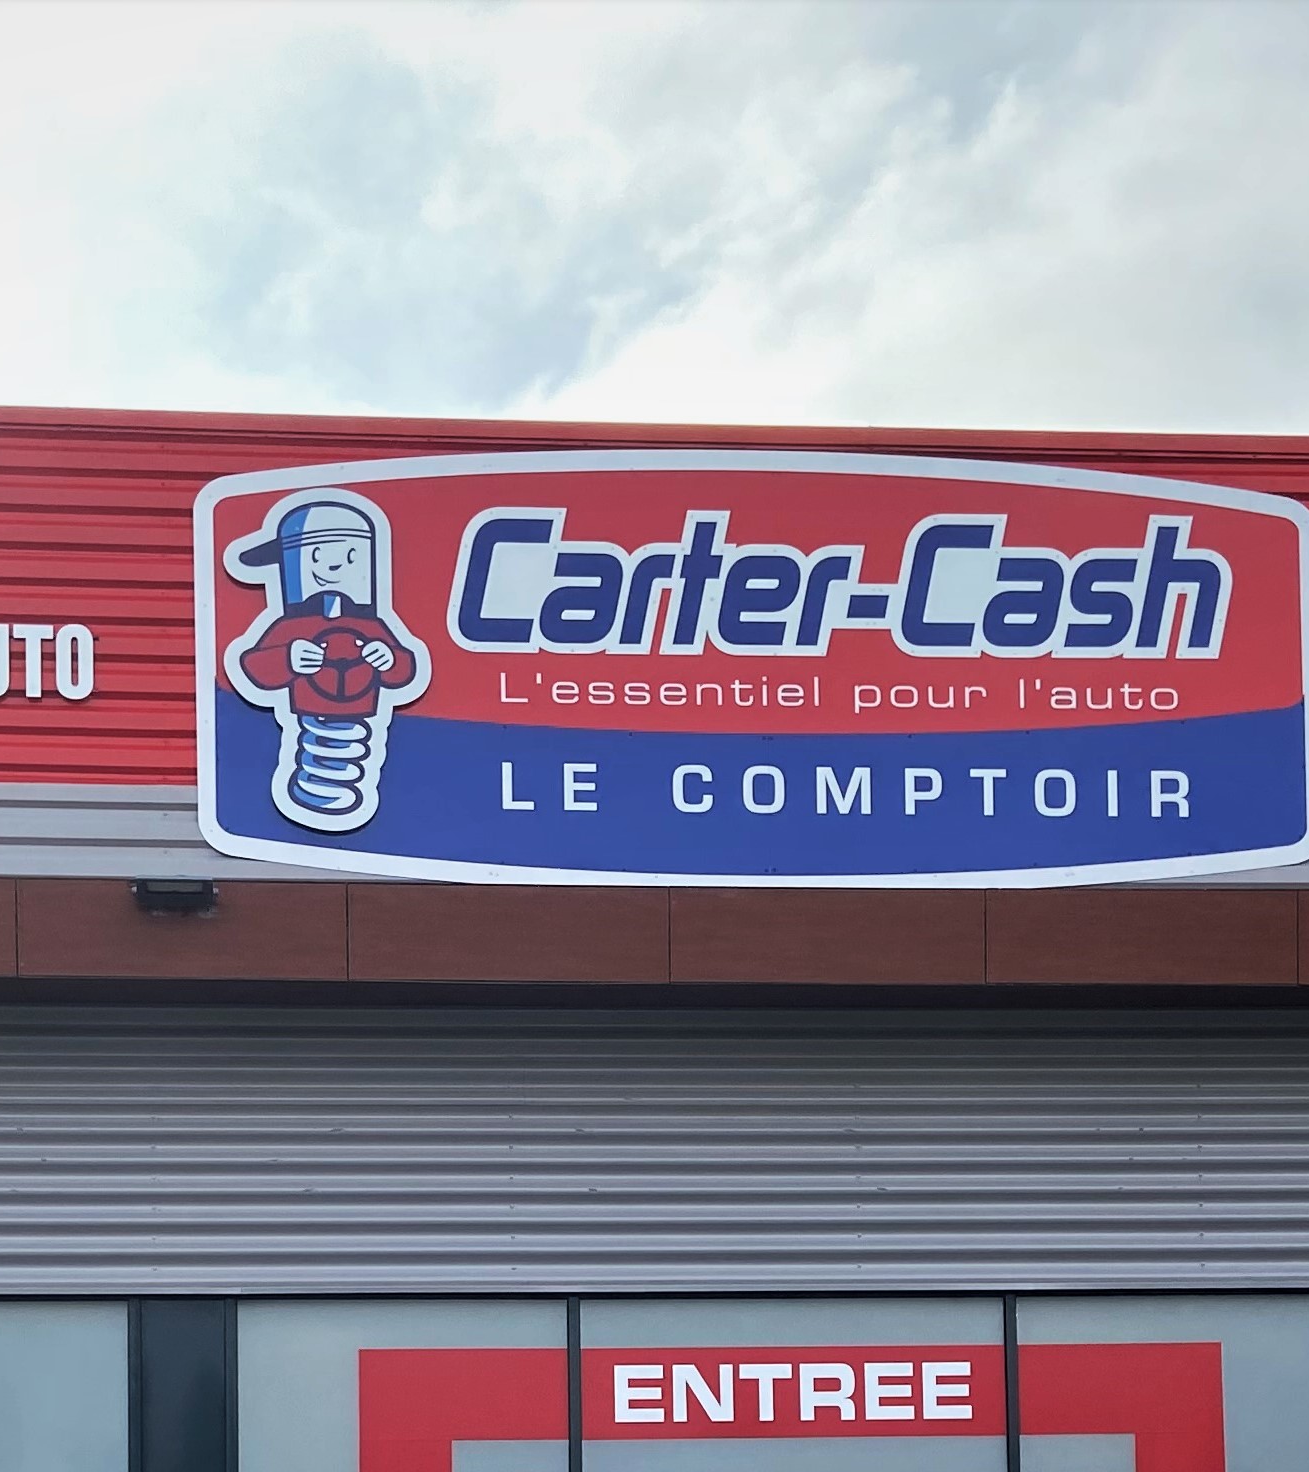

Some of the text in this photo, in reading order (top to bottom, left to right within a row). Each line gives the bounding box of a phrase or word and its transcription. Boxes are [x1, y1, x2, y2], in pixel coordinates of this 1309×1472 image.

[457, 518, 1222, 651] Carter-Cash
[499, 672, 1180, 714] L'essentiel pour l'auto
[502, 761, 1192, 819] LE COMPTOIR
[613, 1361, 974, 1423] ENTREE
